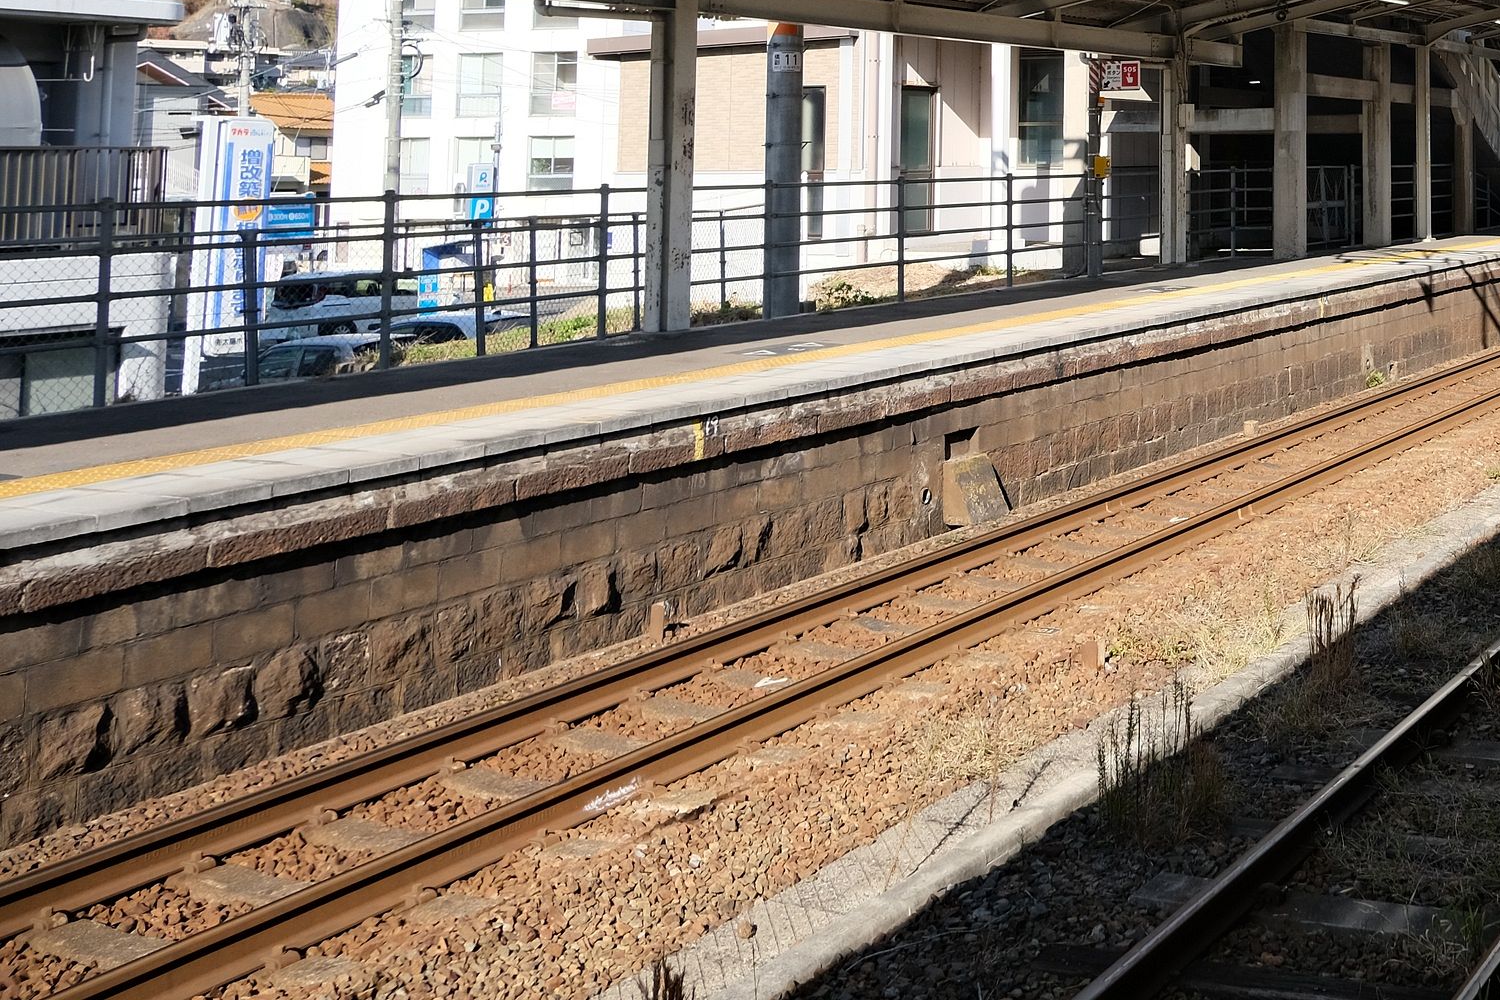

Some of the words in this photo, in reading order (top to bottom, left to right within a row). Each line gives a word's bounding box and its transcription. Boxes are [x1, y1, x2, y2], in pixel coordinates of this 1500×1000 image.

[784, 54, 797, 66] 11
[238, 148, 263, 198] 増改築
[473, 199, 490, 219] P
